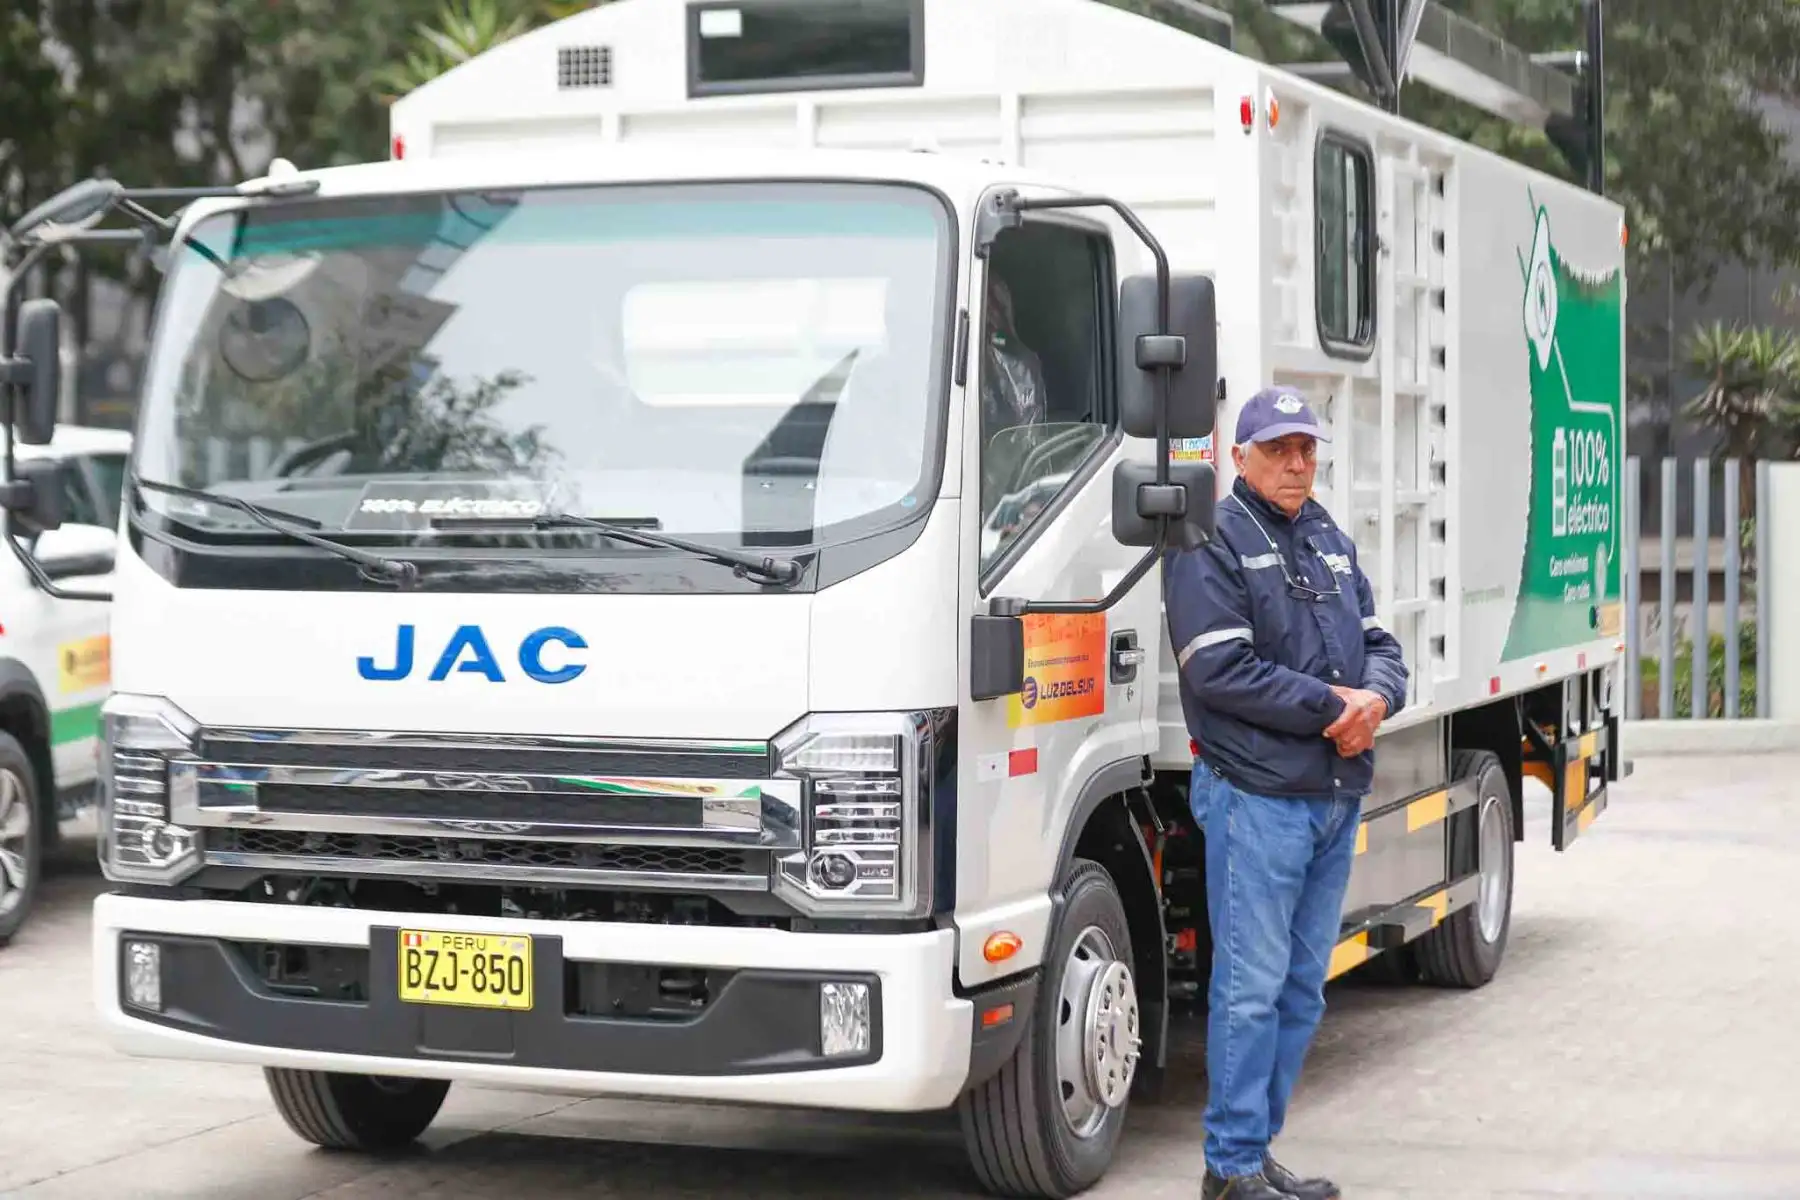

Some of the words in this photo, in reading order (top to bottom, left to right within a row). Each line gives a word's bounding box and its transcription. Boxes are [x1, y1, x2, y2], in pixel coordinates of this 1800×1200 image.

[1569, 428, 1609, 488] 100%
[357, 624, 589, 684] JAC
[861, 868, 889, 877] JAC
[442, 936, 487, 951] PERU
[407, 949, 524, 995] BZJ-850
